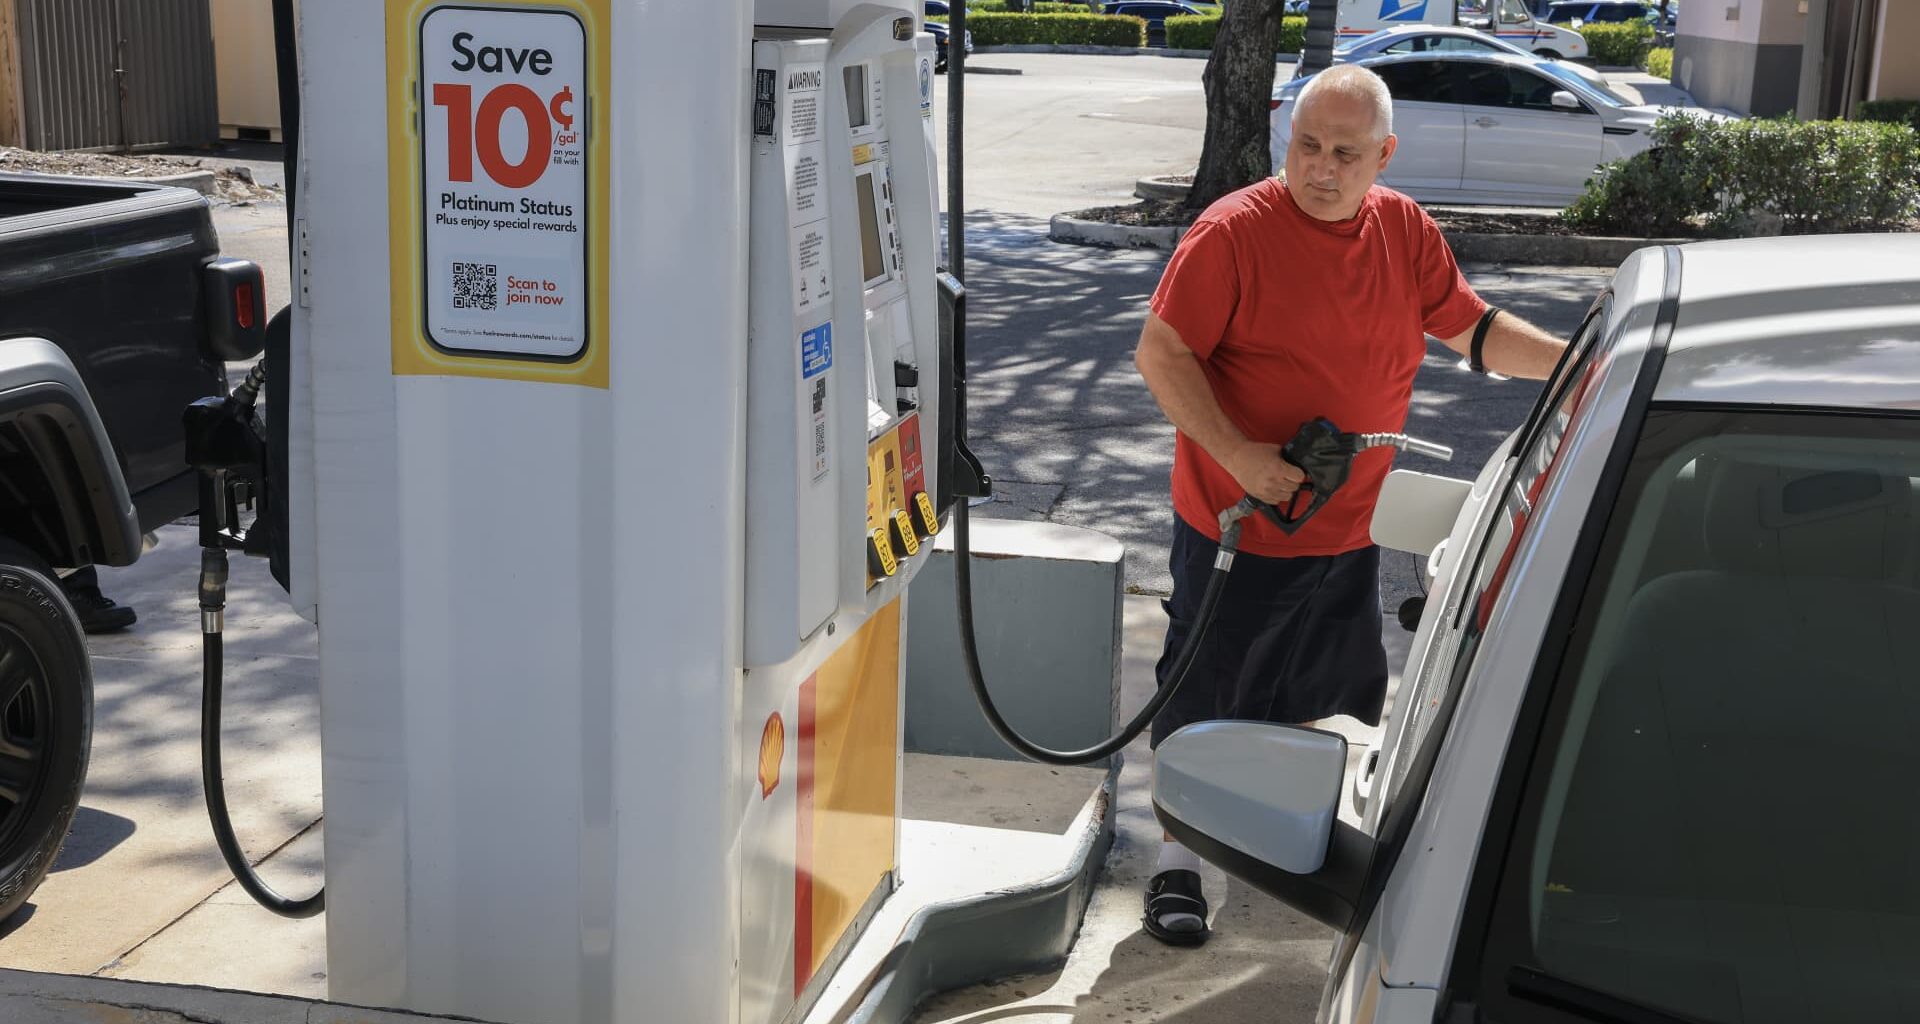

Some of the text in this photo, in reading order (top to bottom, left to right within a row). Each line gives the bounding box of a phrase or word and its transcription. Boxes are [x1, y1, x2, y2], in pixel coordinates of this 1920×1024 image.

[451, 32, 553, 76] Save
[793, 70, 821, 89] WARNING
[565, 149, 580, 158] your
[441, 192, 573, 216] Platinum Status
[436, 213, 577, 232] Plus enjoy special rewards
[507, 276, 556, 291] Scan to
[506, 289, 564, 305] join now
